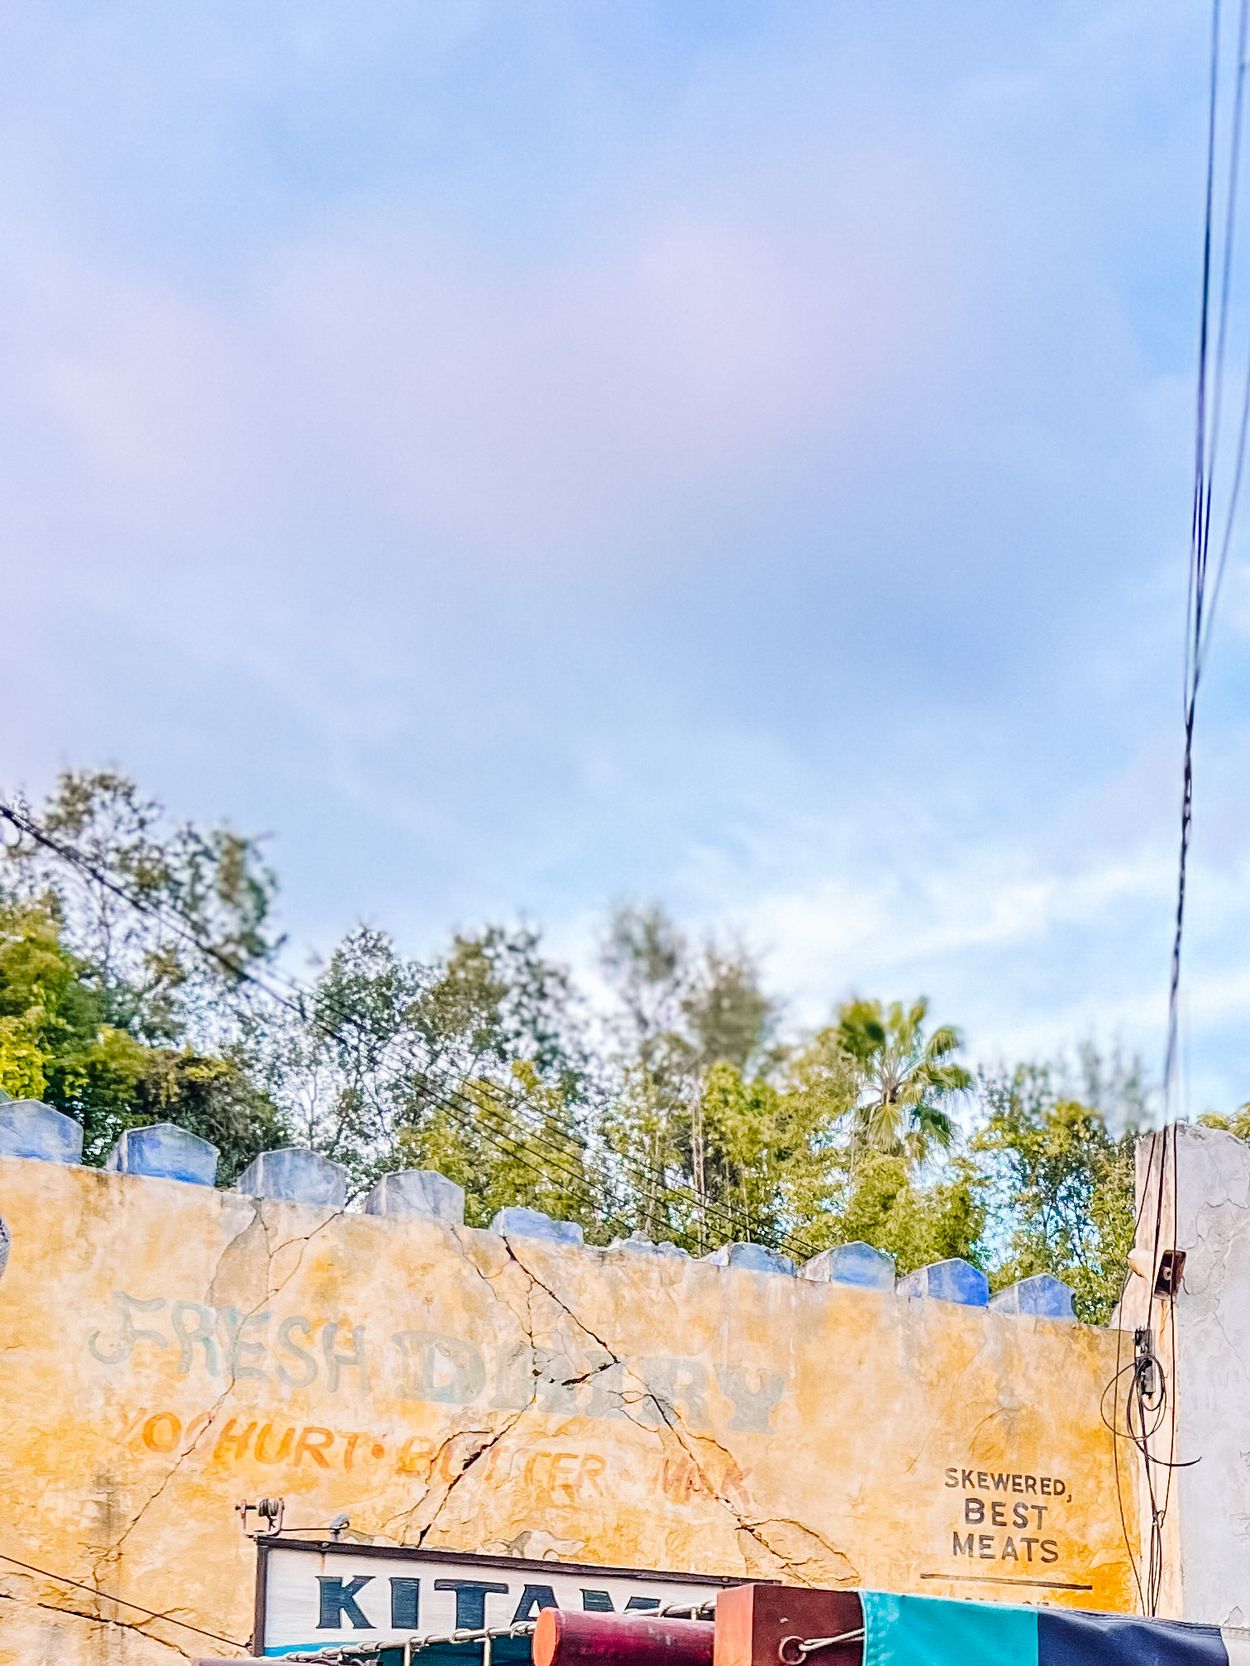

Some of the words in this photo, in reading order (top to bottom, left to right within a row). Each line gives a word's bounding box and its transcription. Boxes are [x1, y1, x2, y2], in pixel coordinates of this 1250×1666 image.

[88, 1290, 370, 1396] FRESH
[944, 1467, 1072, 1503] SKEWERED,
[964, 1497, 1048, 1530] BEST
[952, 1531, 1059, 1563] MEATS
